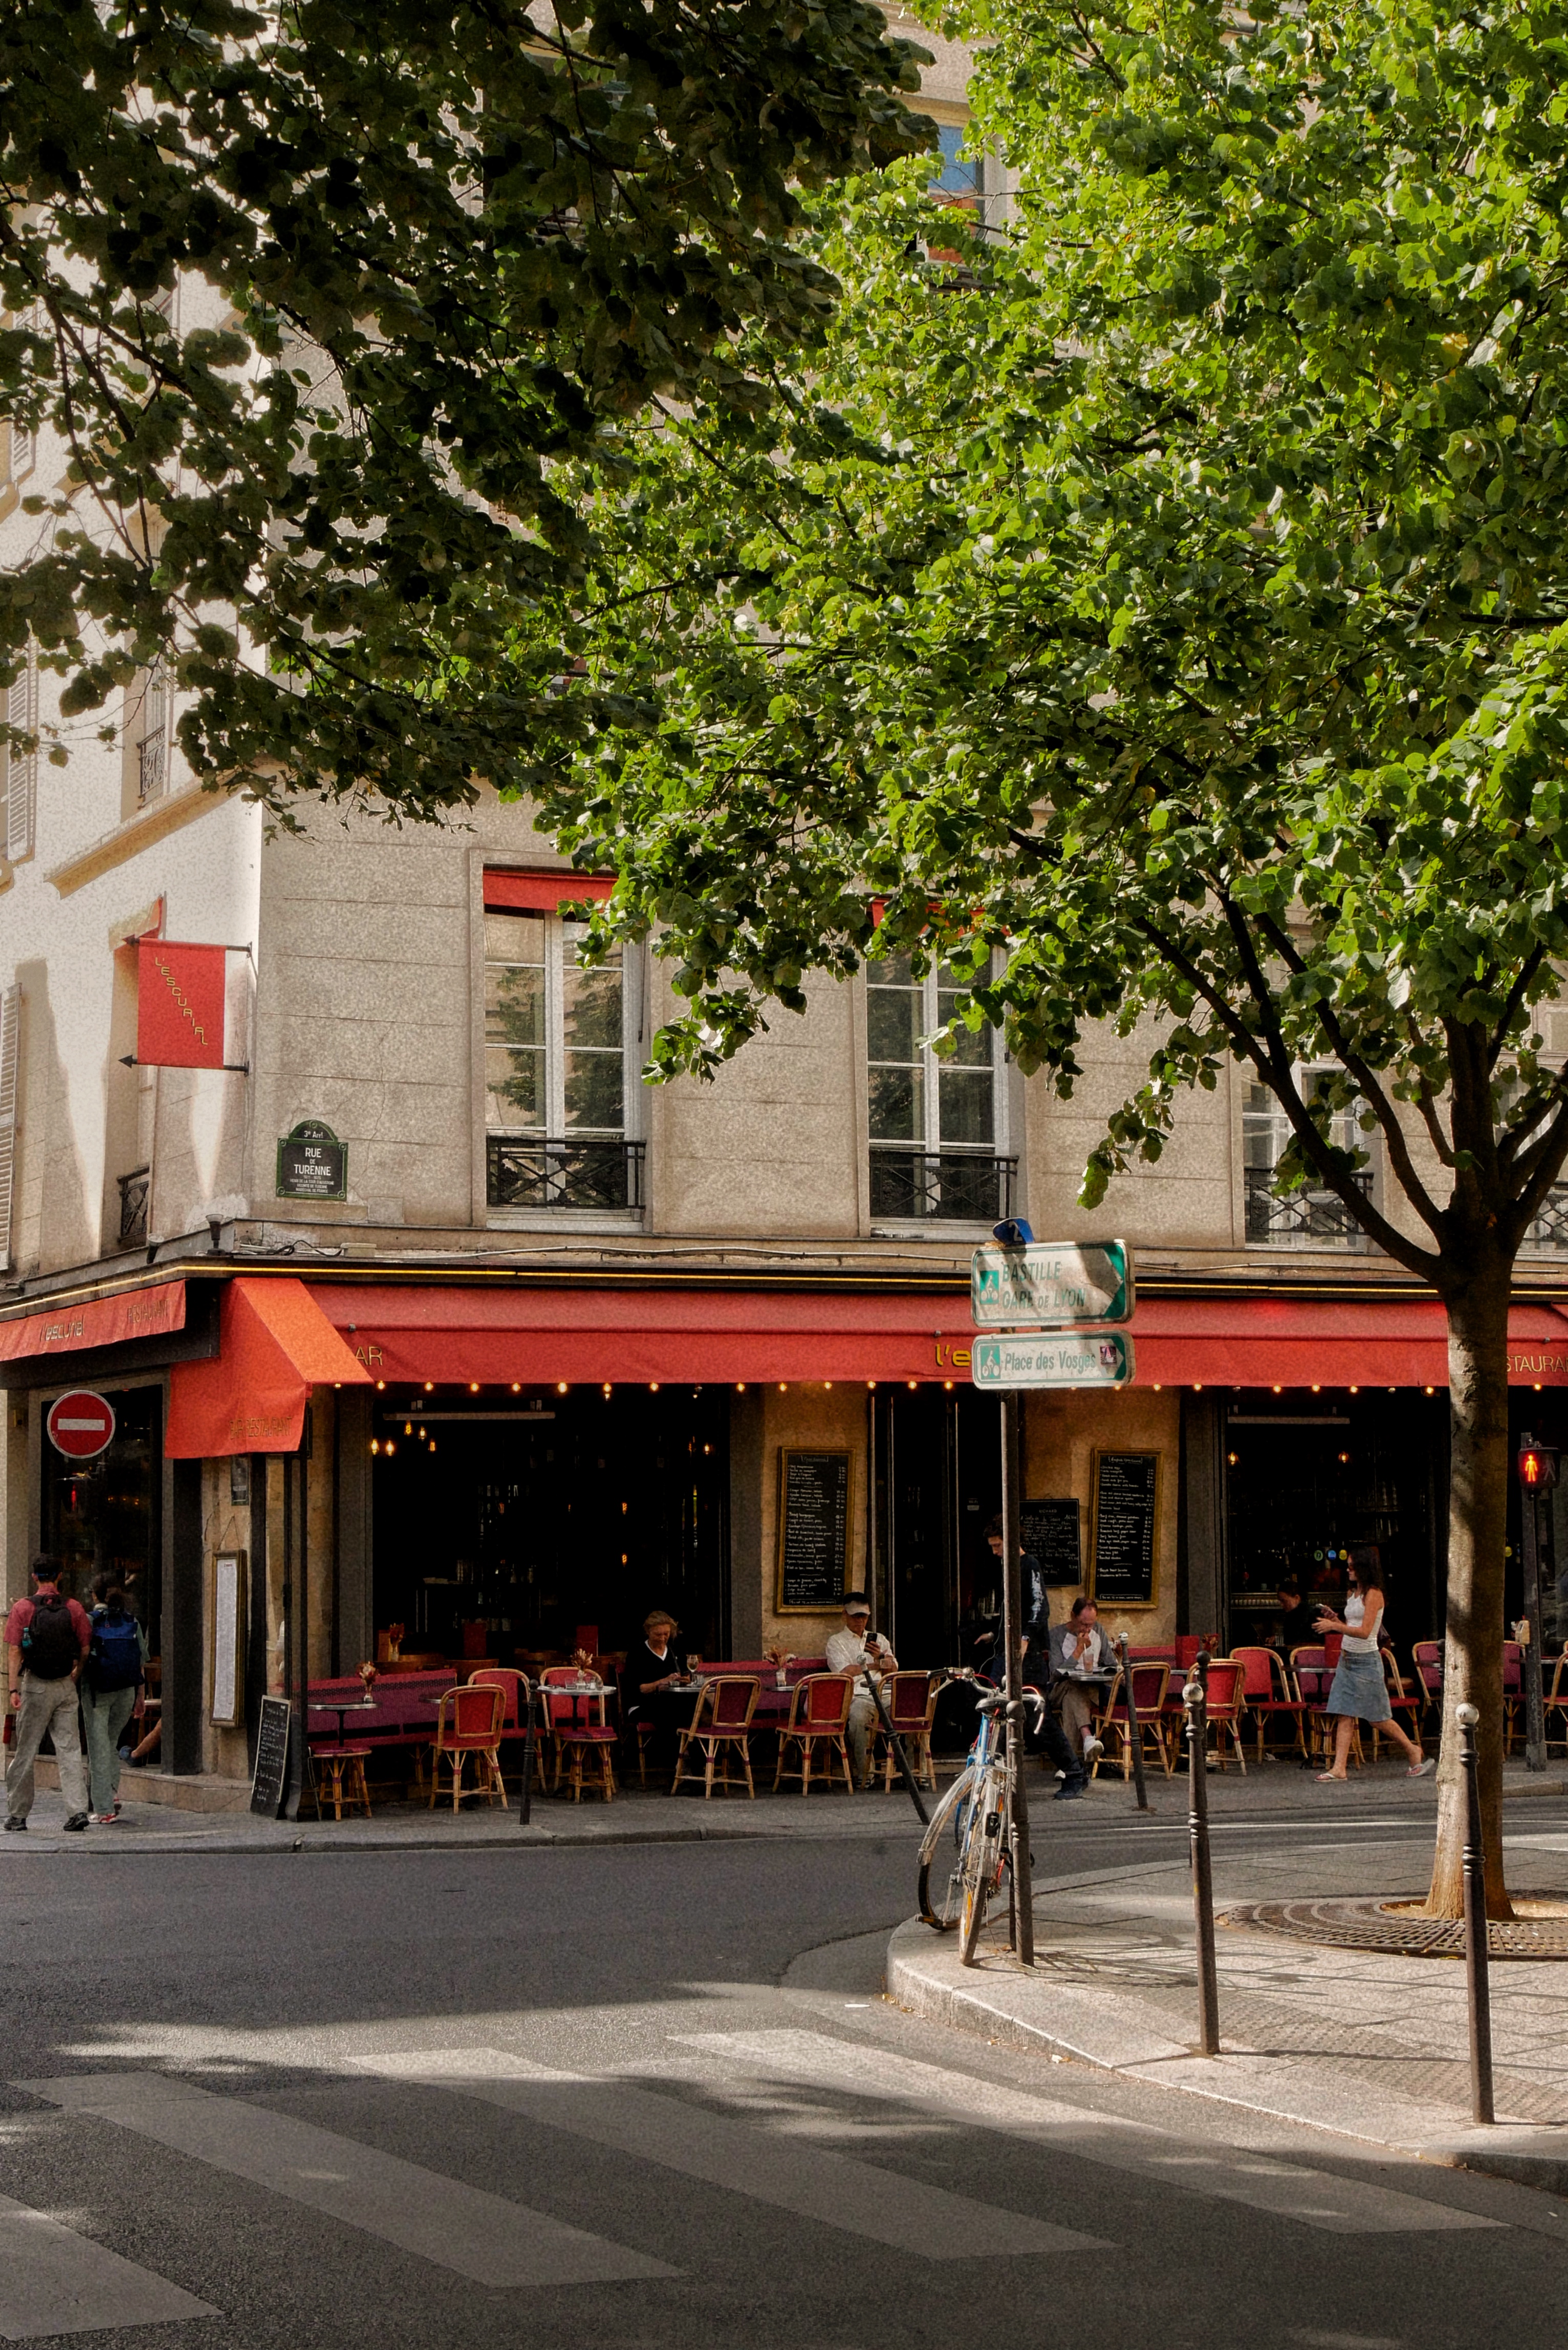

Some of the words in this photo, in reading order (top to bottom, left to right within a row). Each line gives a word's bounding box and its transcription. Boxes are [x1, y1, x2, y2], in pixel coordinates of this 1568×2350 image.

[155, 956, 208, 1045] L'ESCURIAL
[305, 1147, 322, 1158] RUE
[294, 1164, 331, 1176] TURENNE
[1002, 1261, 1061, 1282] BASTILLE
[1002, 1290, 1034, 1310] GARE
[1054, 1288, 1086, 1308] LYON
[127, 1298, 169, 1324] RESTAURANT
[1004, 1352, 1032, 1371] Place
[1036, 1352, 1054, 1370] des
[1058, 1351, 1096, 1375] Vosges
